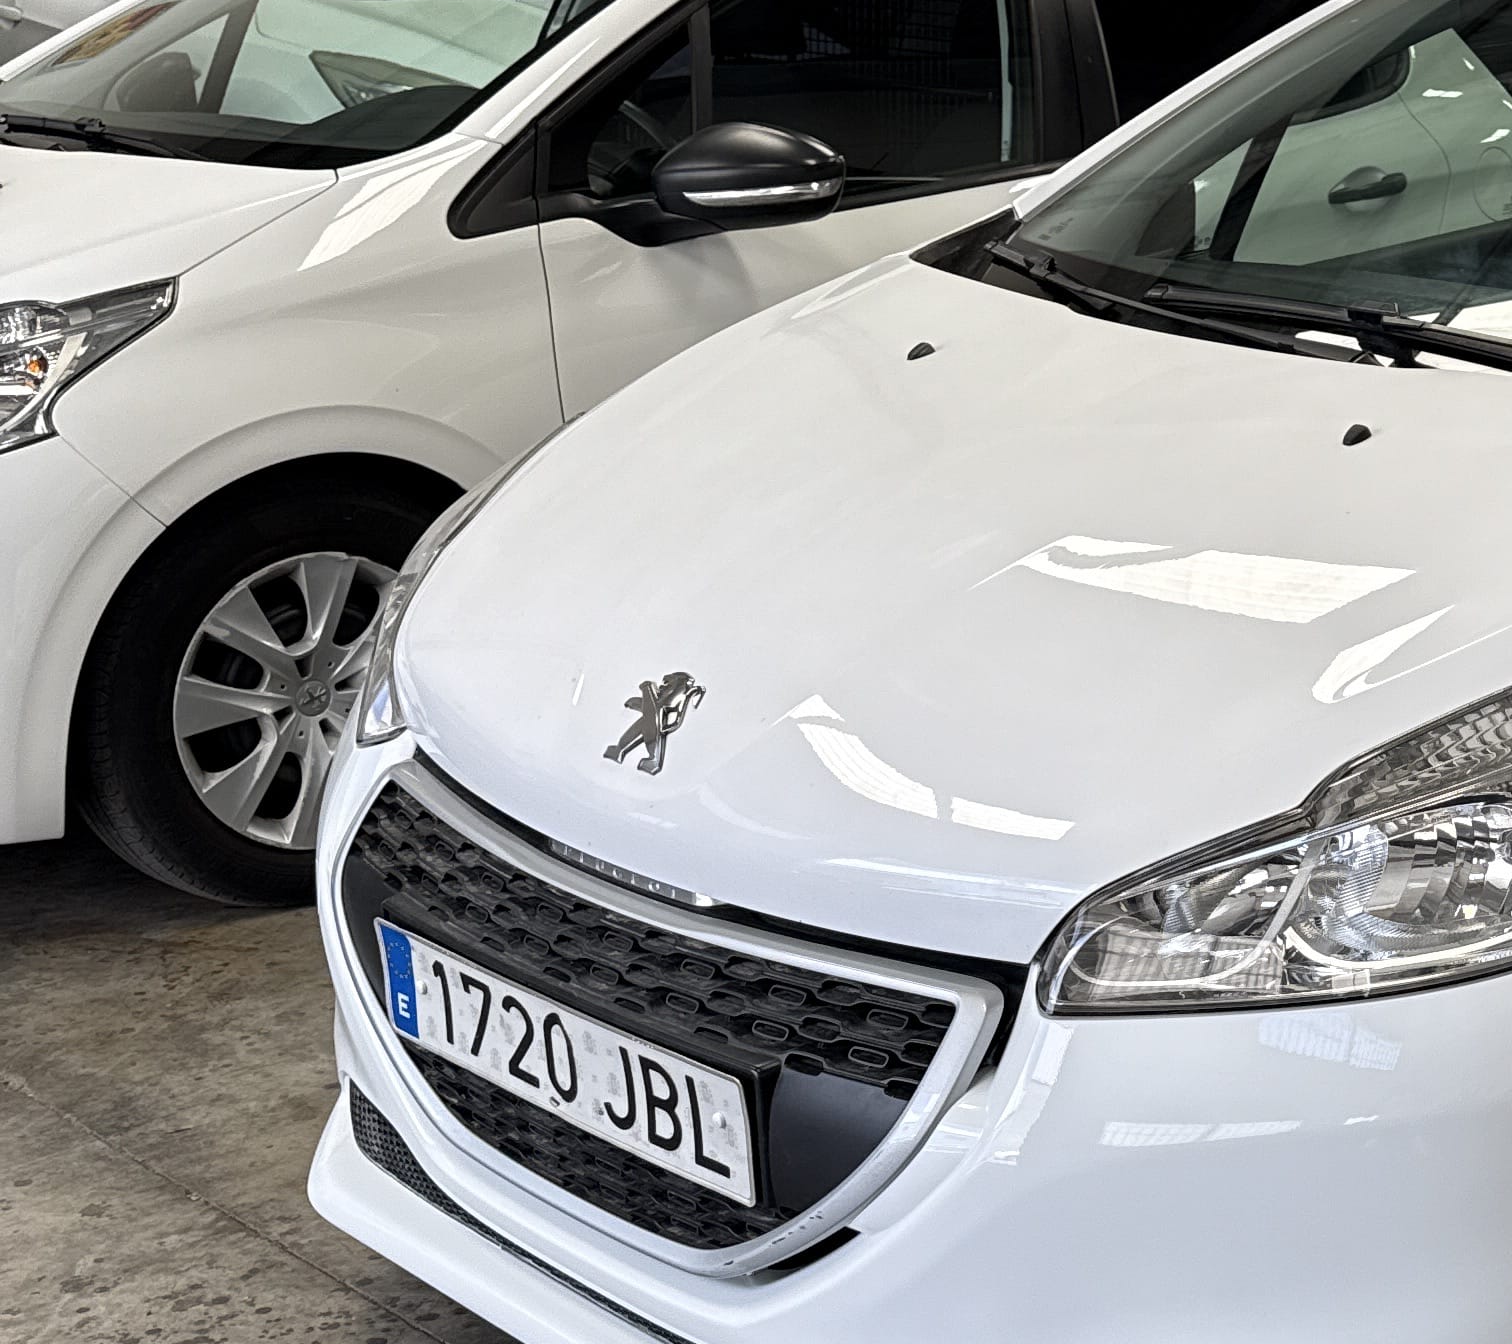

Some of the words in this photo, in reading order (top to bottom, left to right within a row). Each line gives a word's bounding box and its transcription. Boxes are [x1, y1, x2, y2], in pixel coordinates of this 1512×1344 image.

[397, 992, 411, 1019] E
[432, 959, 578, 1103] 1720
[604, 1046, 731, 1179] JBL
